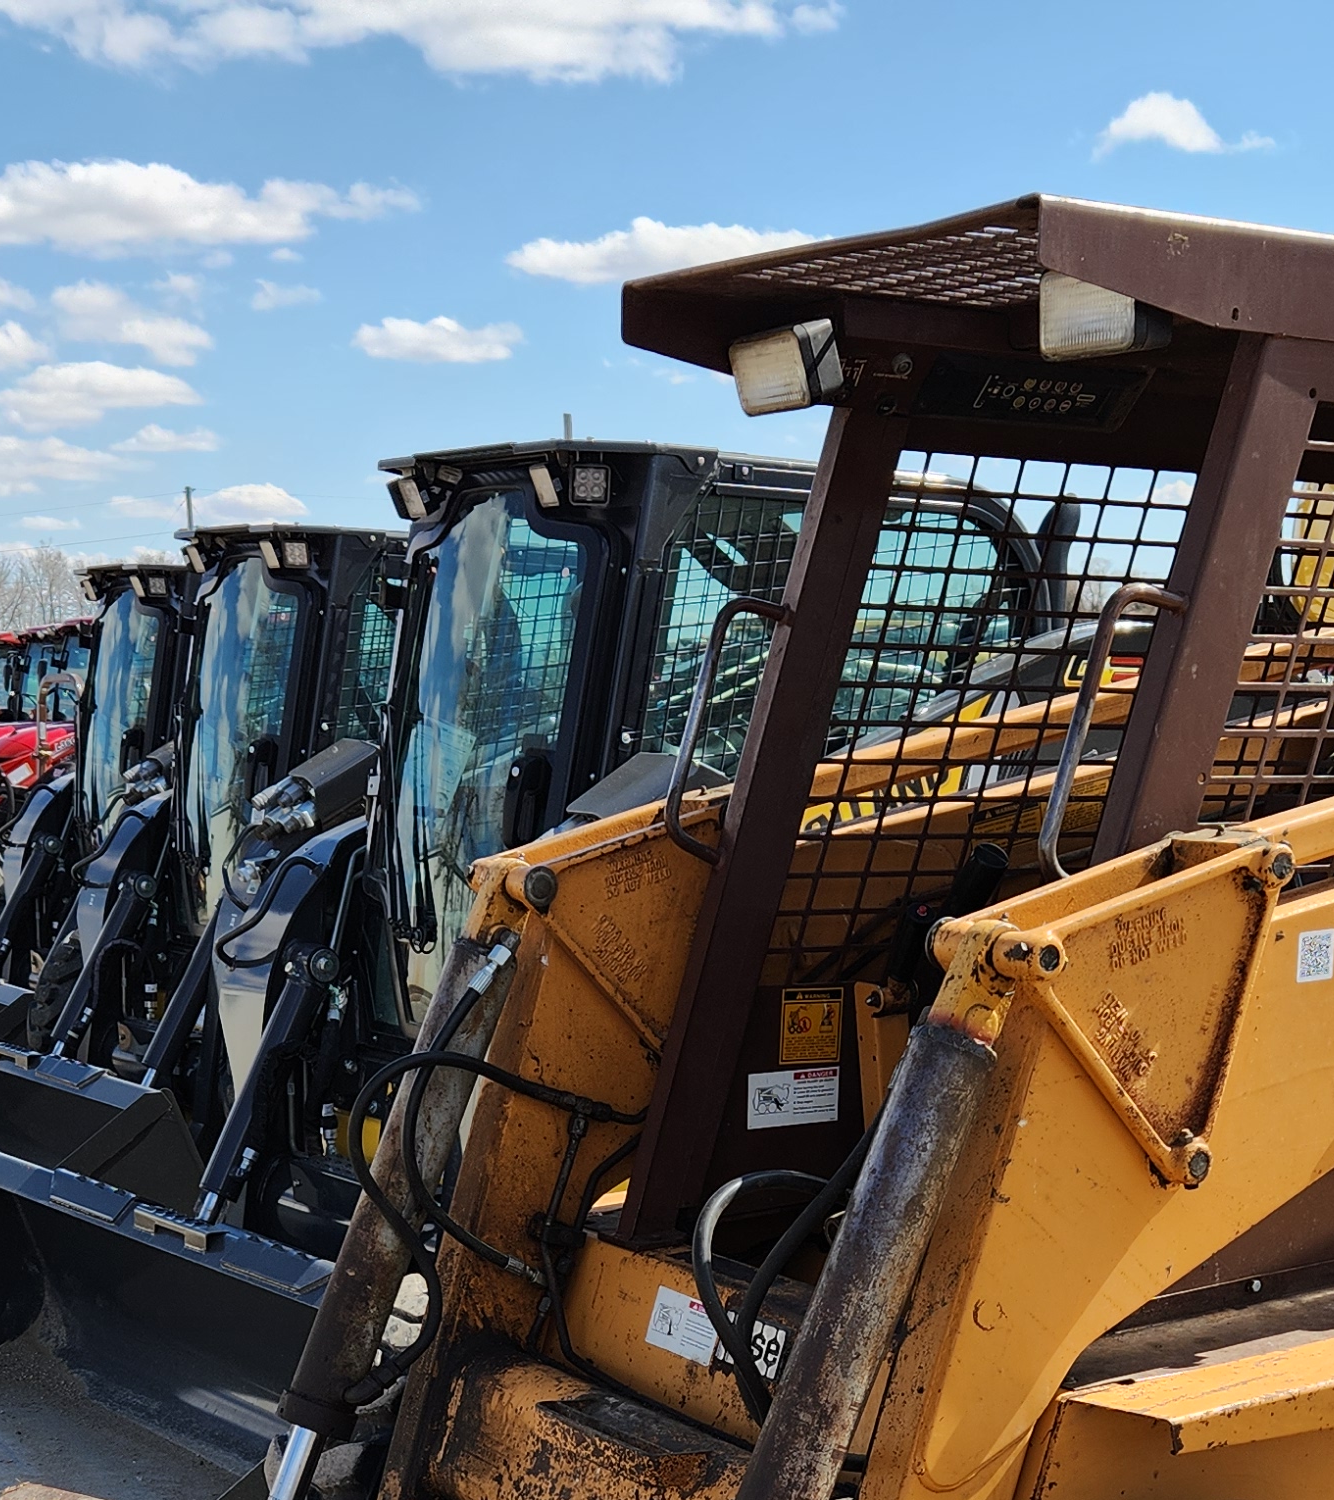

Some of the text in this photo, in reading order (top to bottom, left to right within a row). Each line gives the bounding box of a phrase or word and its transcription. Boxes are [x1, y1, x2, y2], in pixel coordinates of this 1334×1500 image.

[606, 850, 653, 873] WARNING
[1116, 906, 1168, 936] WARNING
[807, 1070, 834, 1079] DANGER
